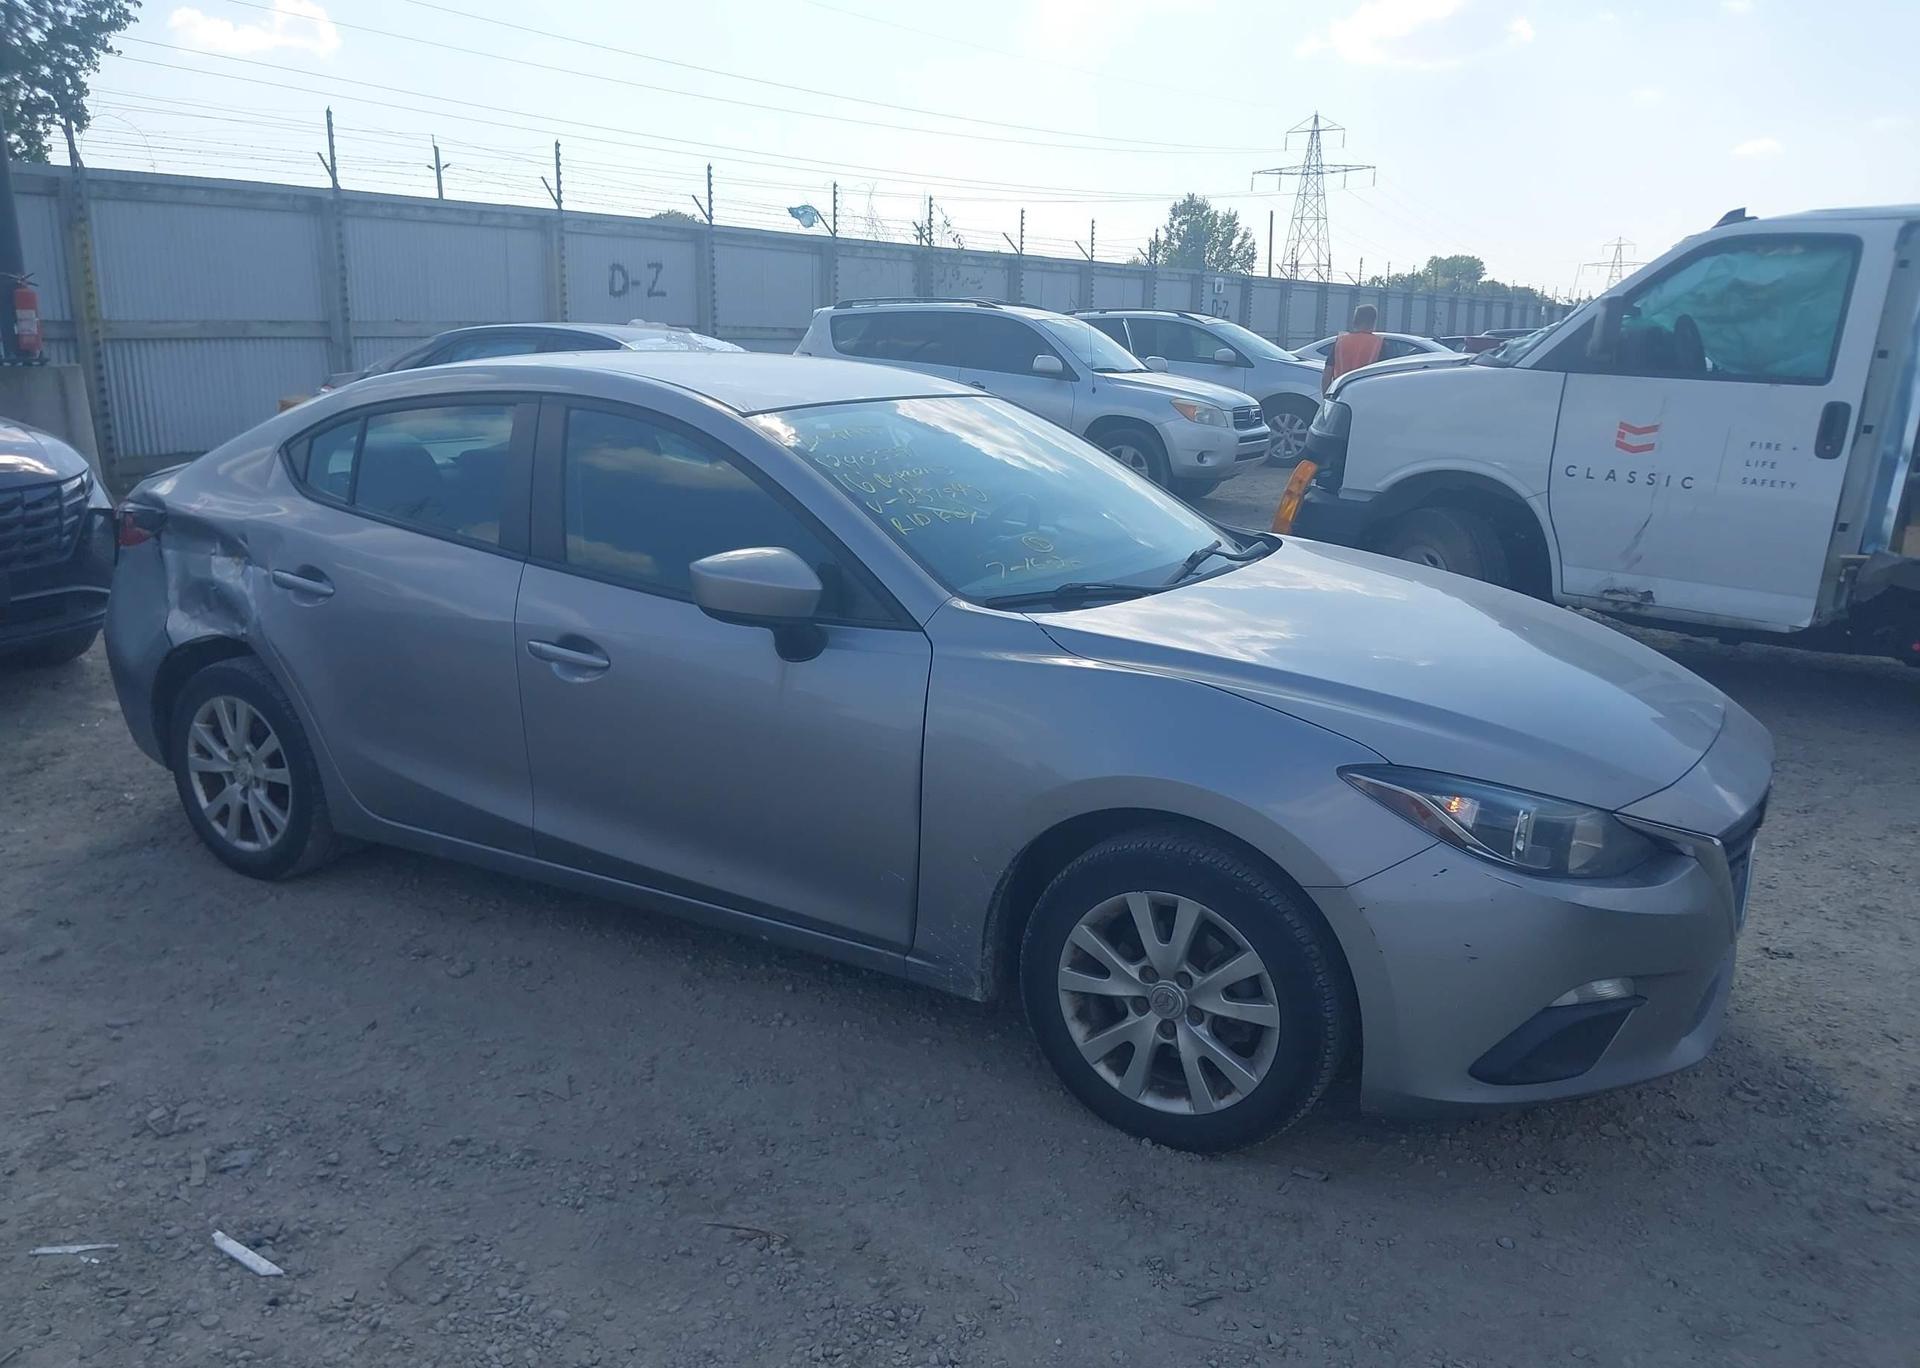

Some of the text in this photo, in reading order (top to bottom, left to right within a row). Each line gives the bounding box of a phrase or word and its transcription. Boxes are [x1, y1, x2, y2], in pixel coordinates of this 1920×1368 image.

[608, 262, 667, 298] D-Z
[1749, 440, 1782, 452] FIRE
[1745, 459, 1777, 470] LIFE
[1564, 464, 1695, 490] CLASSIC
[1741, 477, 1798, 489] SAFETY
